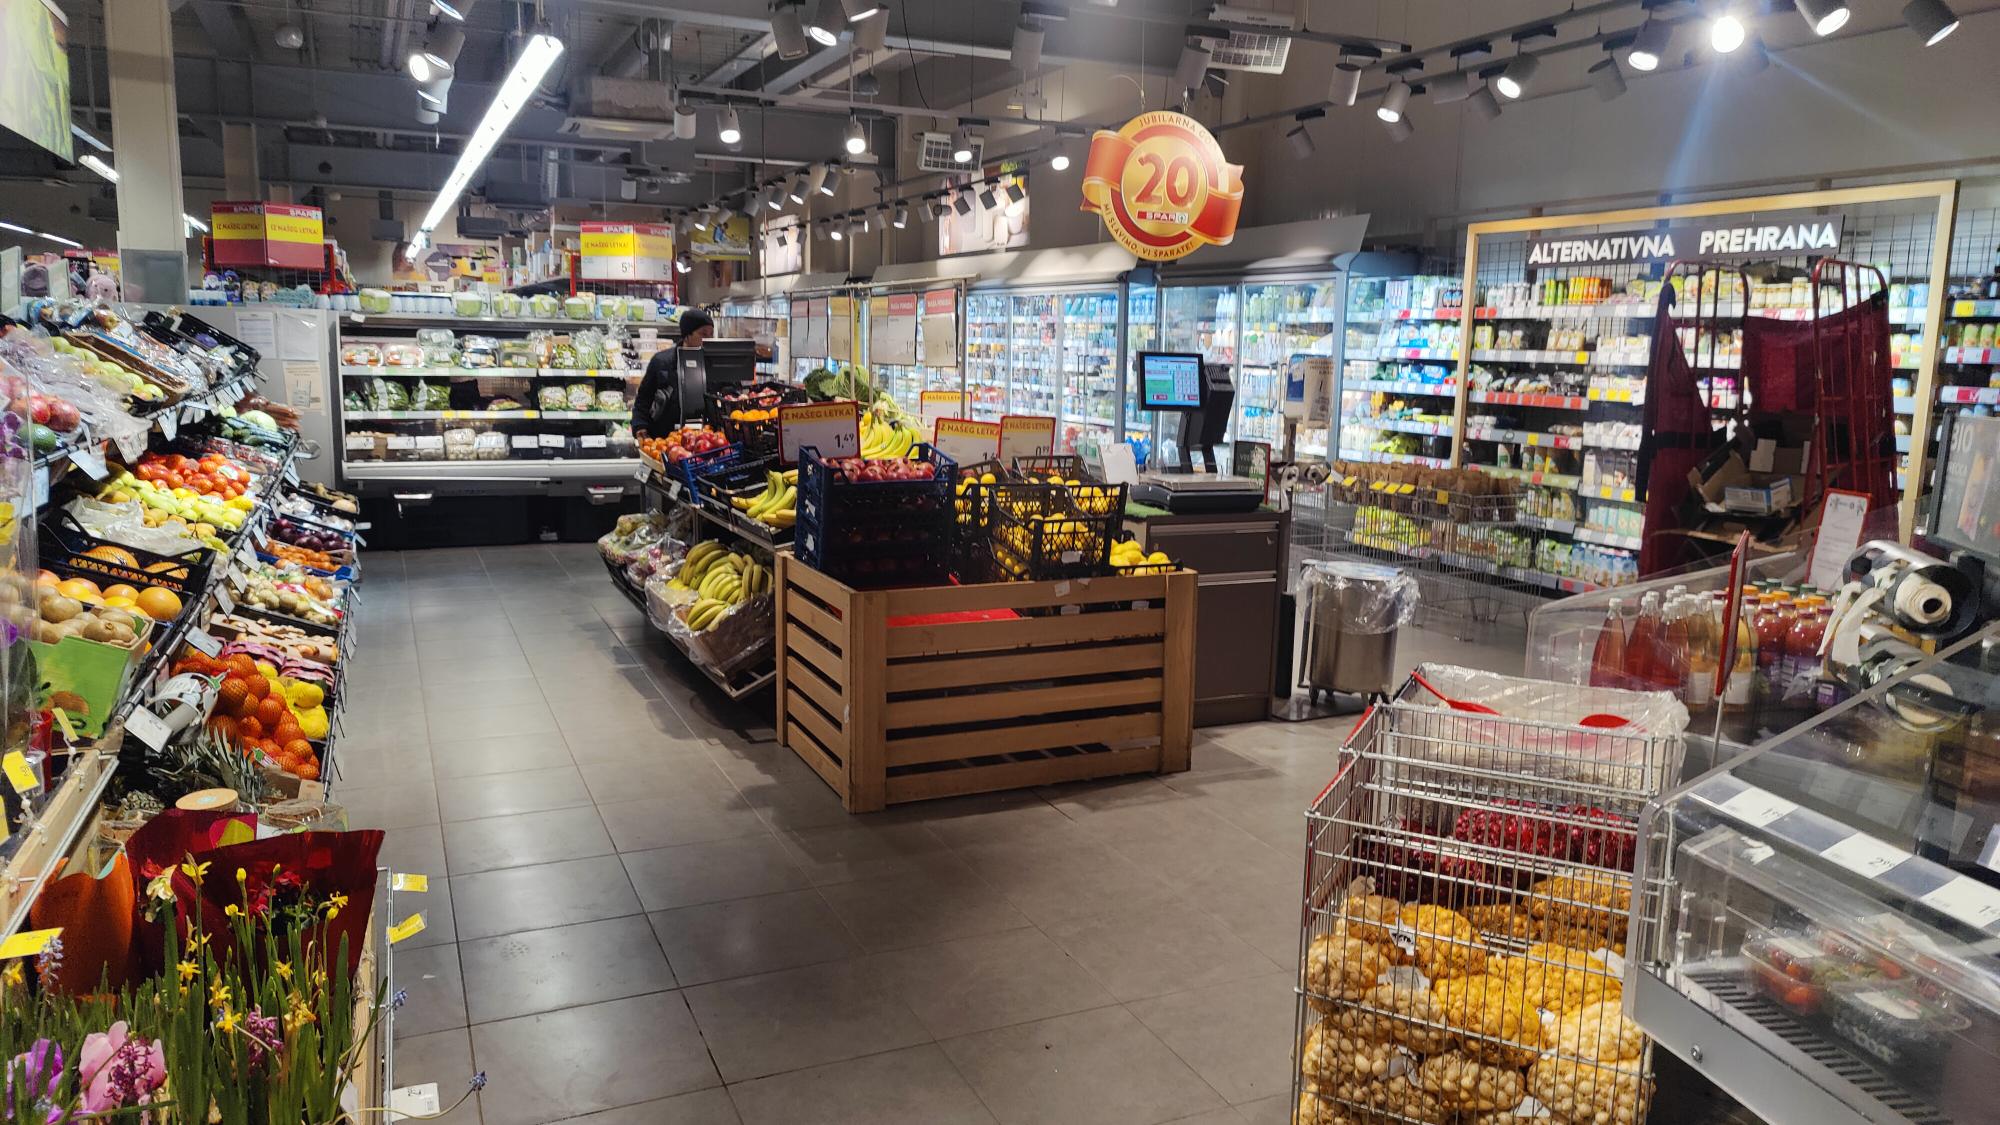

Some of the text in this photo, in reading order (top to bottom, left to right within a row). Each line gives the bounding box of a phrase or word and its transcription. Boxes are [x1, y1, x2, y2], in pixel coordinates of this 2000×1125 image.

[1139, 113, 1197, 134] JUBILARNA
[1134, 152, 1199, 209] 20
[1145, 211, 1175, 223] SPAR
[1528, 222, 1838, 265] ALTERNATIVNA PREHRANA
[791, 410, 823, 420] NAŠEG
[824, 407, 854, 418] LETKA!
[947, 423, 975, 434] NAŠEG
